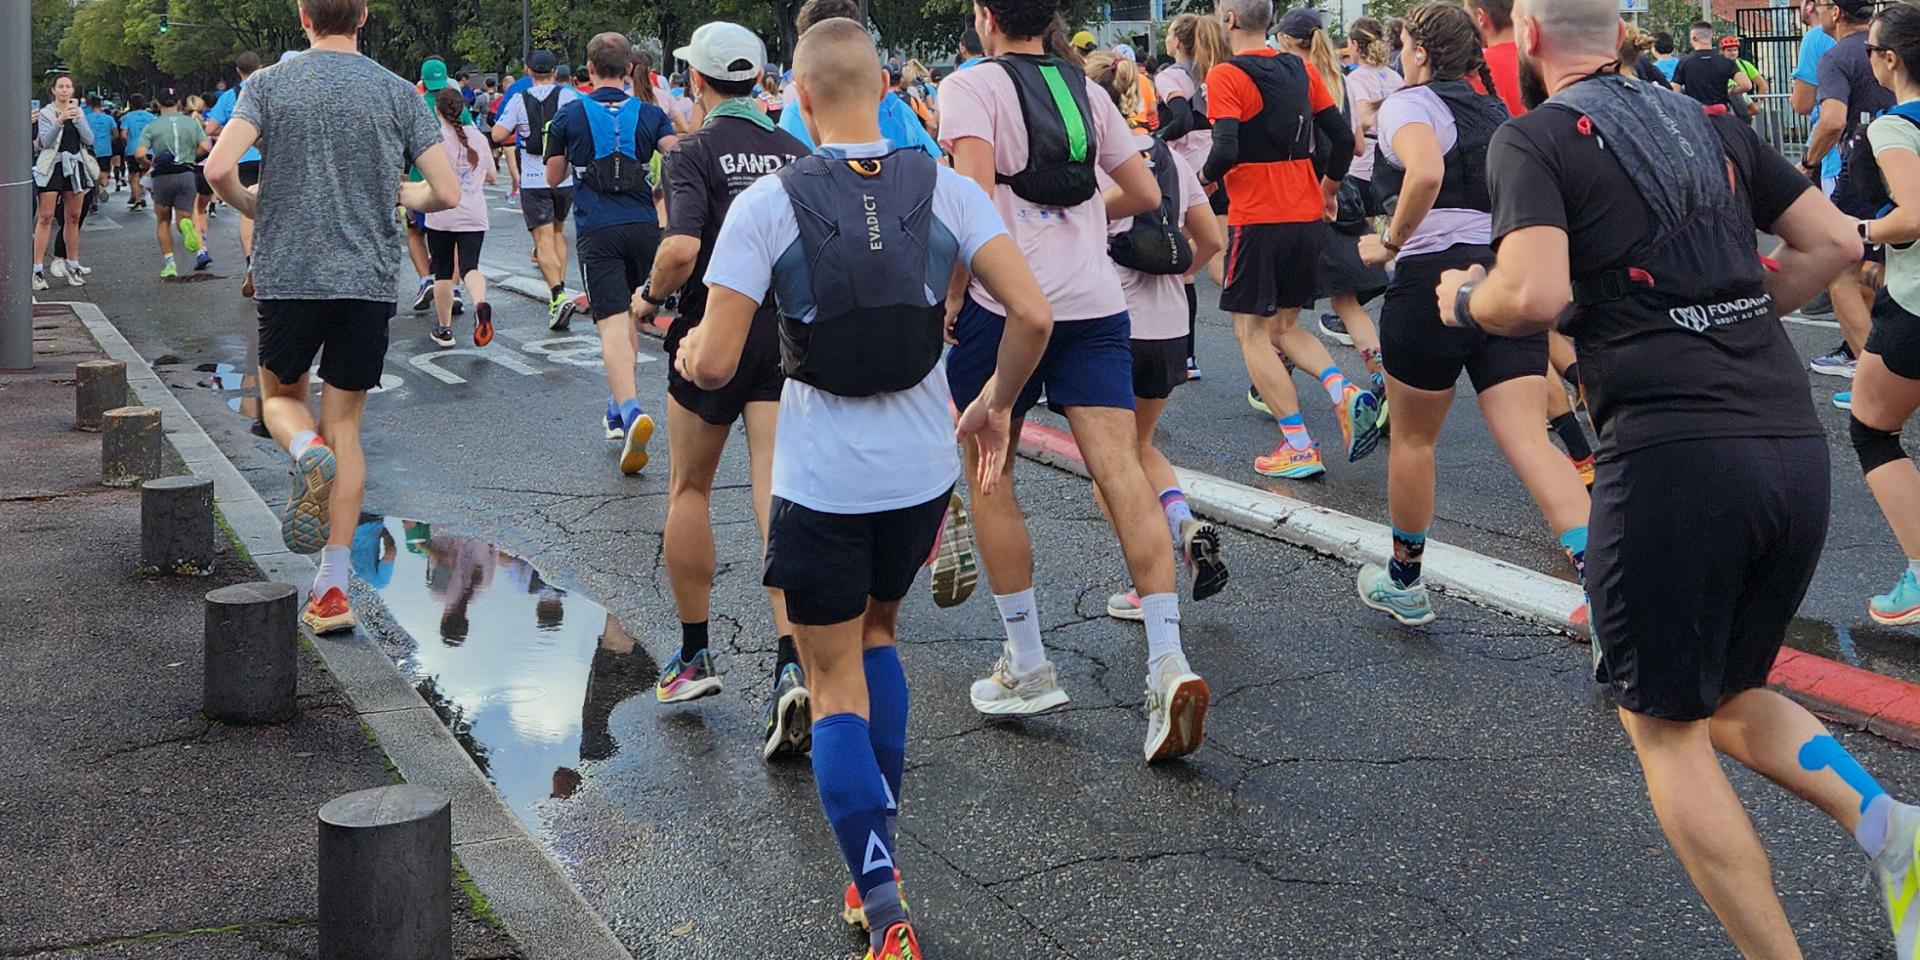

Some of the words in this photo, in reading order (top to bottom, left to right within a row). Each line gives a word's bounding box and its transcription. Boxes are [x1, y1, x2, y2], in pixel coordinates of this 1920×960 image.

[719, 152, 797, 175] BAND
[863, 194, 883, 250] EVADICT
[1167, 232, 1178, 265] EVADICT
